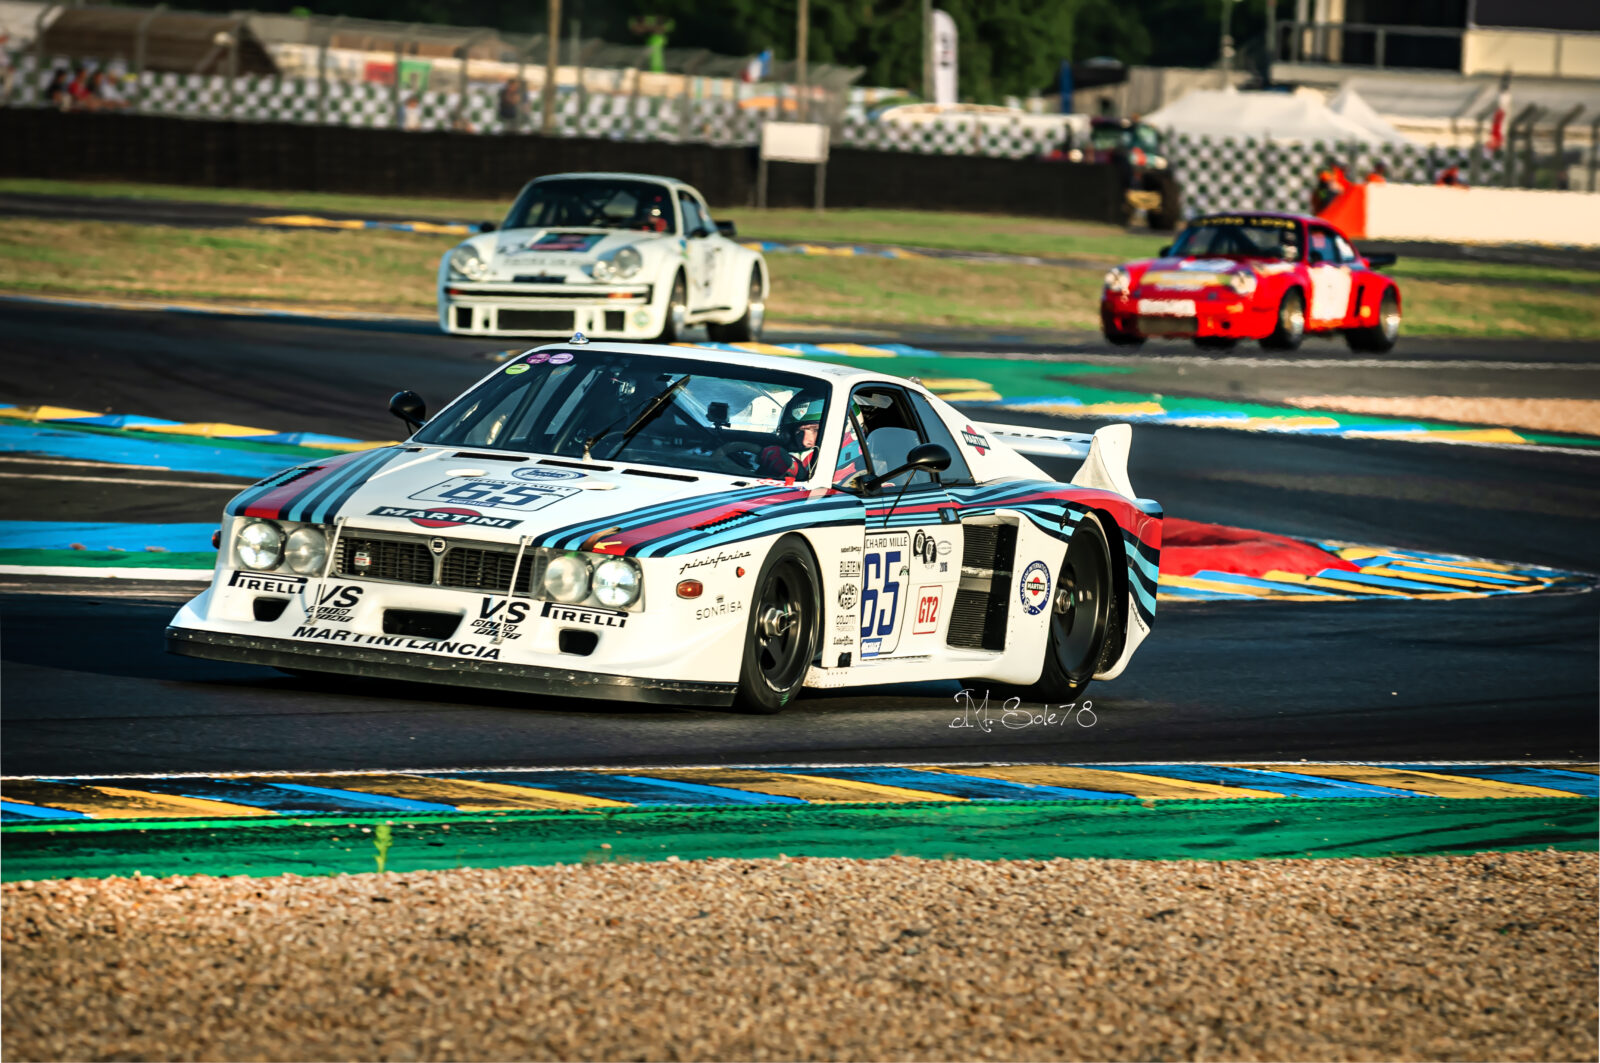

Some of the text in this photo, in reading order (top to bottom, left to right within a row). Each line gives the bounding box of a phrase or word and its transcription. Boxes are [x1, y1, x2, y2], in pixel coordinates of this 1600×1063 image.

[438, 482, 557, 505] 65
[379, 507, 515, 527] MARTINI
[890, 537, 907, 547] MILLE
[679, 550, 752, 575] pininfarina
[228, 570, 309, 595] PIRELLI
[861, 551, 901, 637] 65
[1027, 583, 1045, 591] MARTINI
[314, 584, 364, 607] VS
[479, 597, 531, 623] VS
[540, 602, 630, 628] PIRELLI
[696, 600, 743, 620] SONRISA
[918, 596, 939, 624] GT2
[292, 626, 501, 660] MARTINI LANCIA
